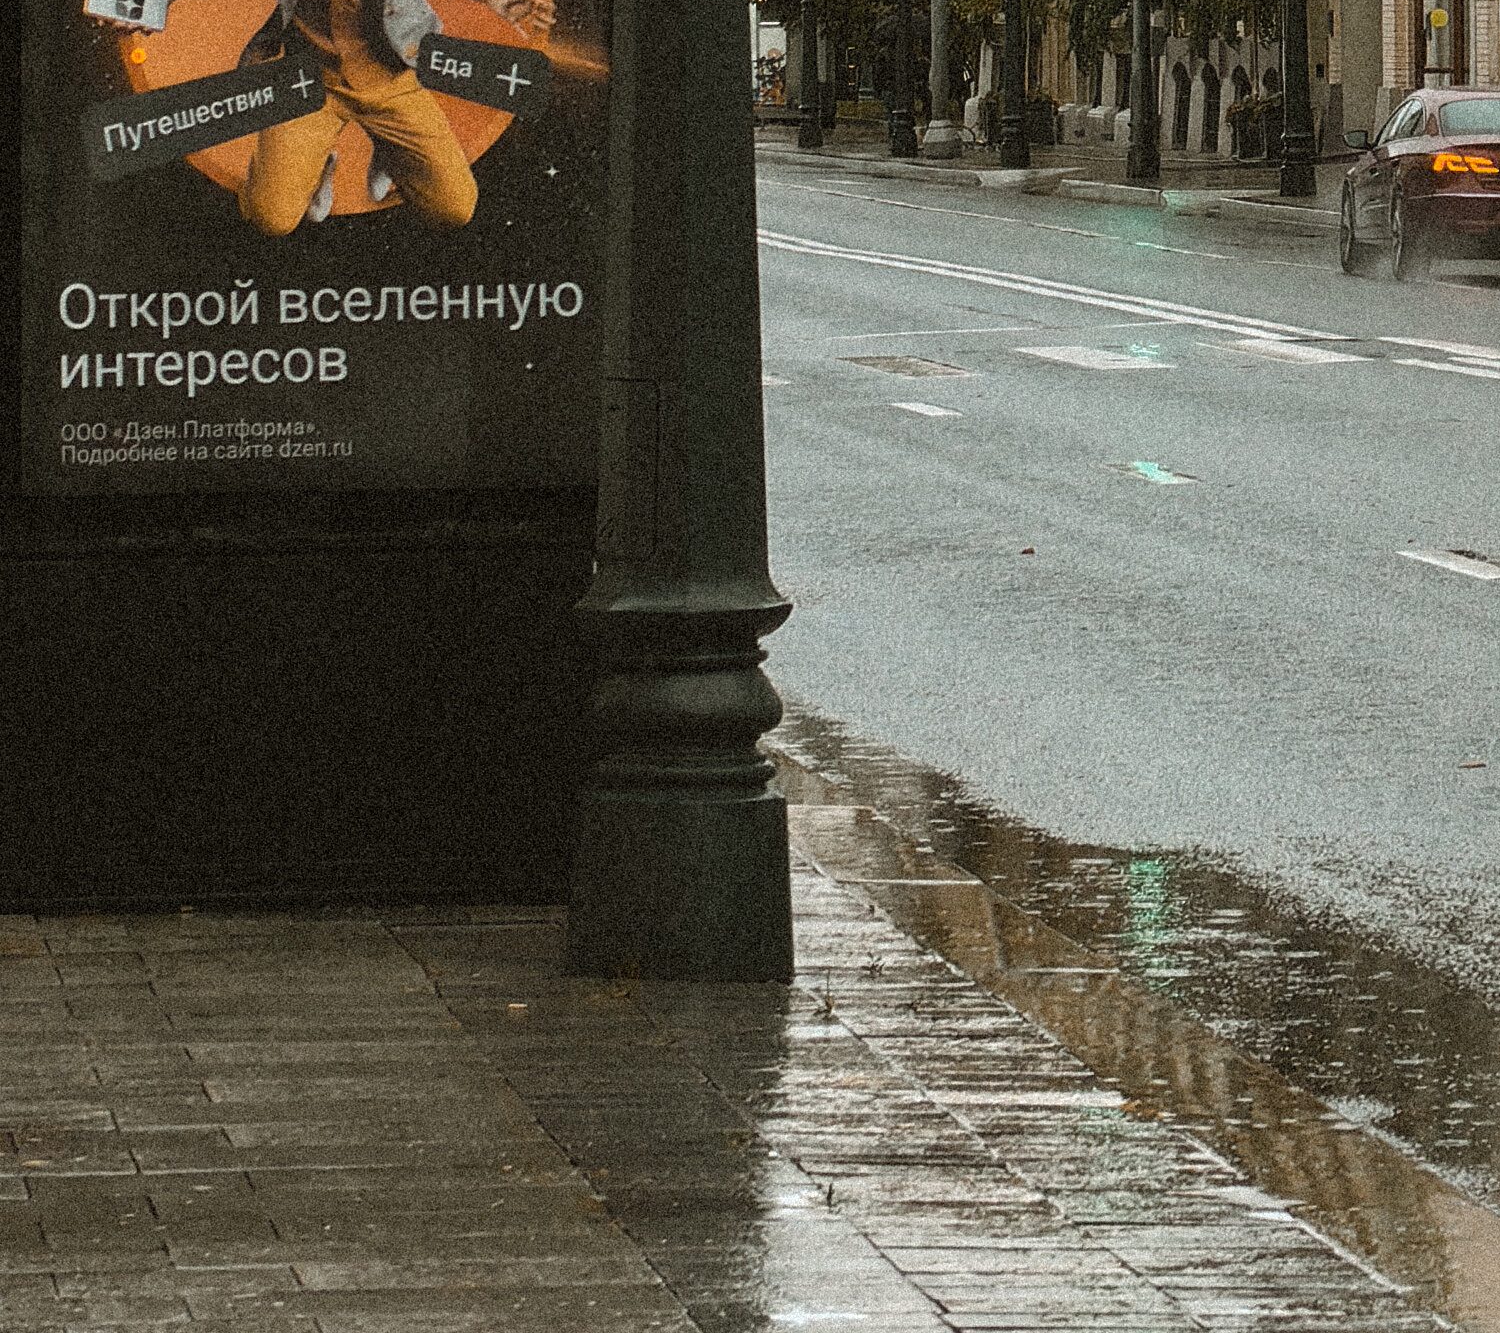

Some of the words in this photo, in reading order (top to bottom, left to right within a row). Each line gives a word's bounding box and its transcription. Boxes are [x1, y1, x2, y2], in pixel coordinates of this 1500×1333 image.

[429, 49, 474, 80] Еда
[102, 85, 277, 153] Путешествия
[58, 278, 261, 339] Открой
[278, 279, 584, 331] вселенную
[60, 344, 349, 398] интересов
[60, 422, 108, 442] ООО
[60, 442, 178, 467] Подробнее
[183, 445, 209, 461] на
[213, 439, 274, 461] сайте
[278, 439, 354, 459] dzen.ru
